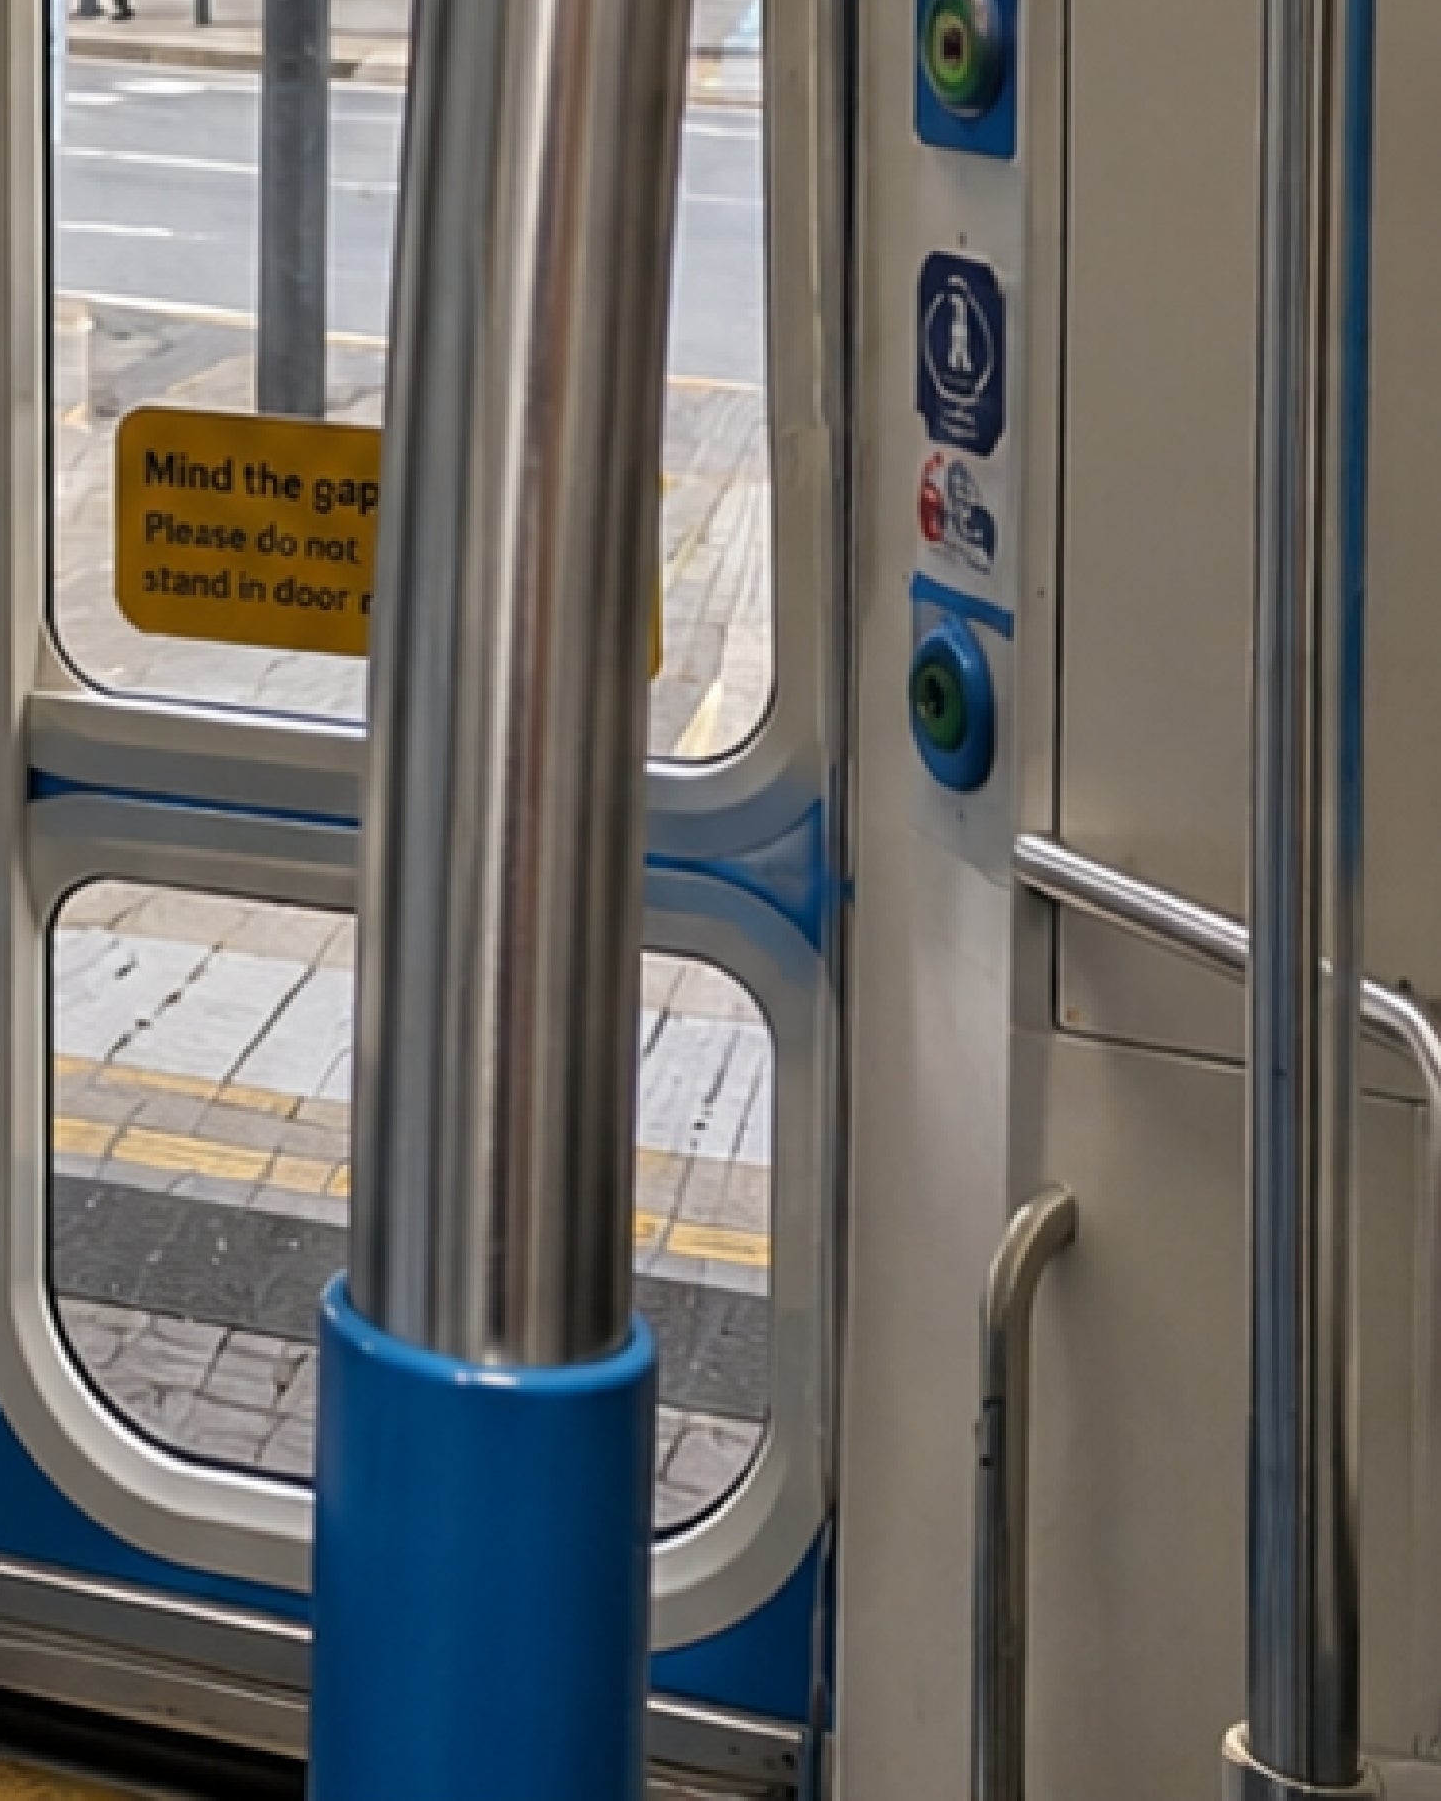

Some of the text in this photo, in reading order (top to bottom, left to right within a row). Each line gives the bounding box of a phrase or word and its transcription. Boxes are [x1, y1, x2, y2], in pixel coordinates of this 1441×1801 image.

[143, 448, 381, 518] Mind the gap
[144, 510, 361, 565] Please do not
[143, 565, 231, 599] stand
[238, 570, 267, 602] in
[273, 576, 350, 610] door
